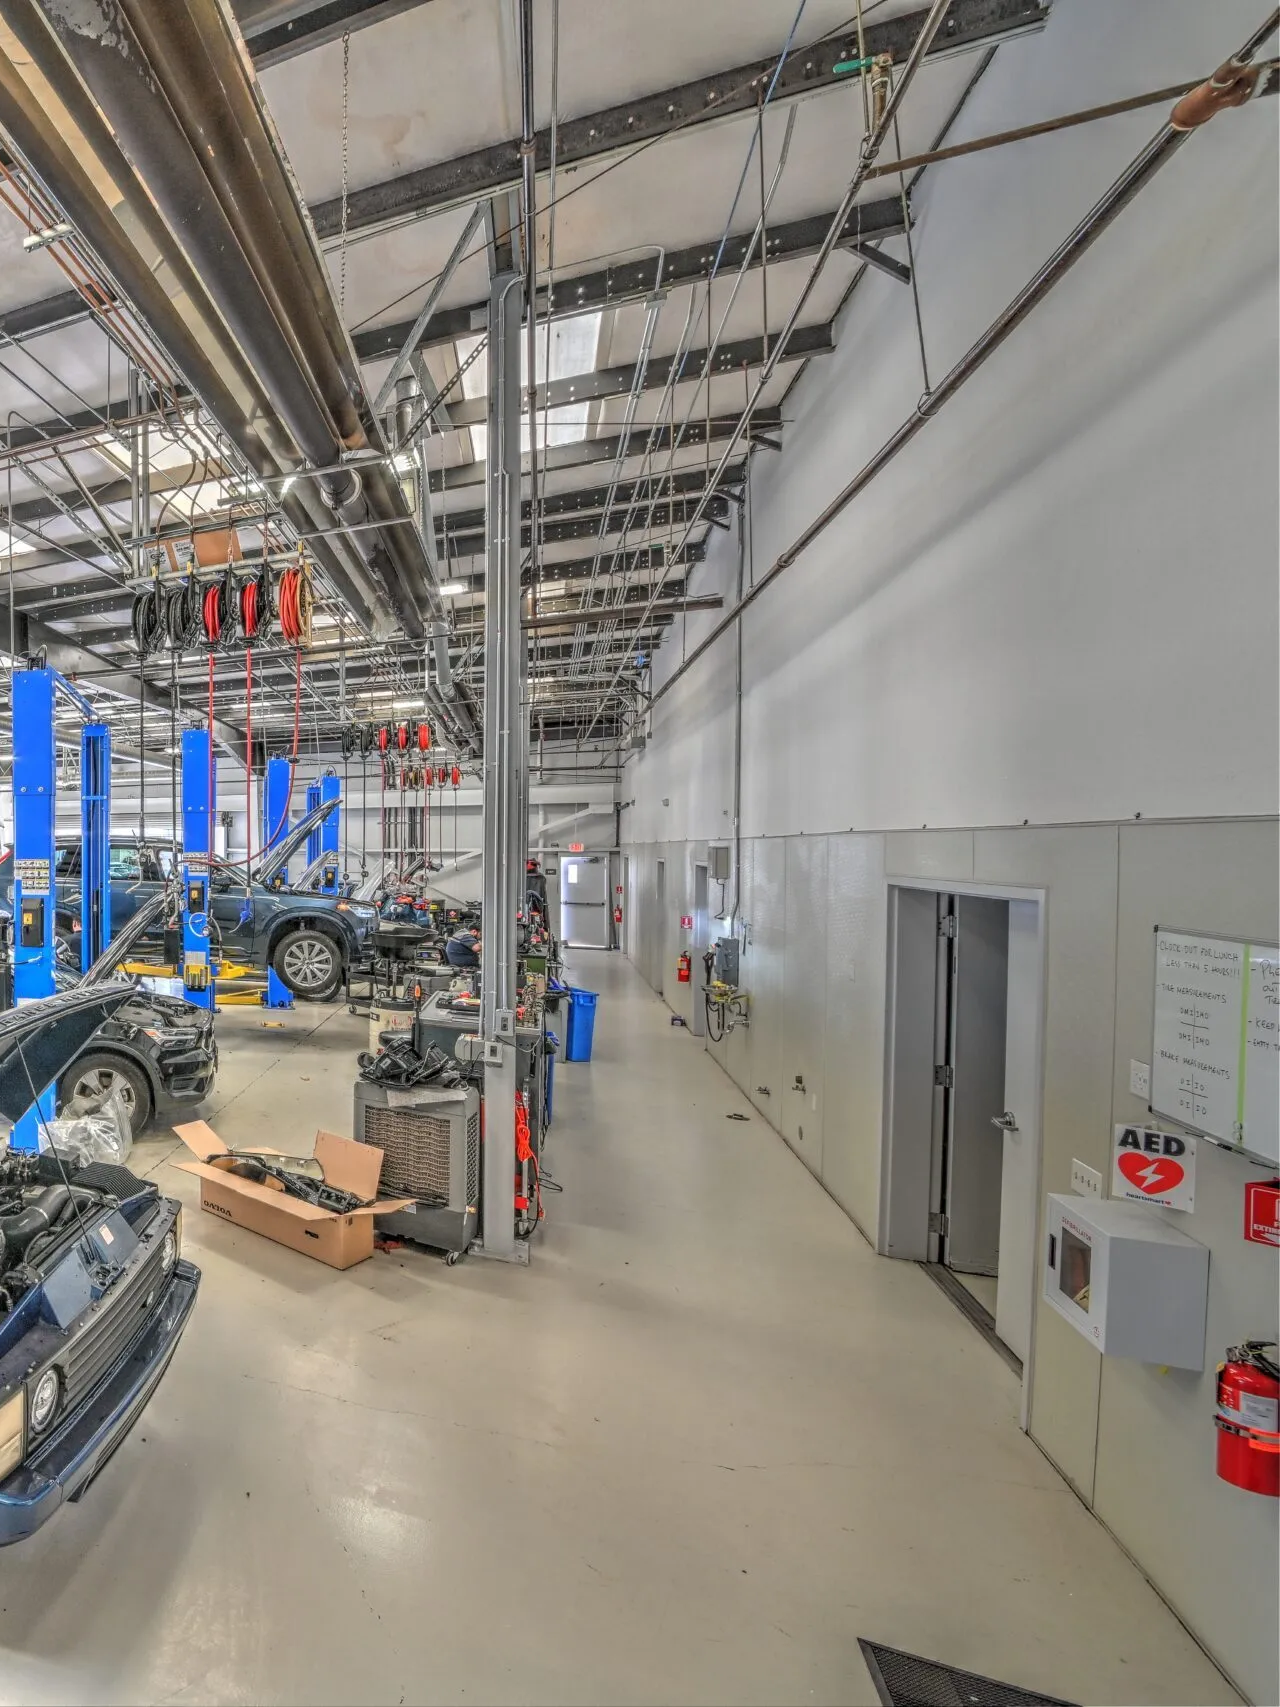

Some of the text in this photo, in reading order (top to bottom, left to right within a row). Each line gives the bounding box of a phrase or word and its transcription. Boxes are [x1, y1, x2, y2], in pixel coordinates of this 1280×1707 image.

[1214, 950, 1239, 960] LUNCH
[1184, 961, 1200, 970] THAN
[1177, 987, 1226, 1003] MEASUREMENTS
[1118, 1128, 1186, 1157] AED
[203, 1200, 233, 1217] VOLVO
